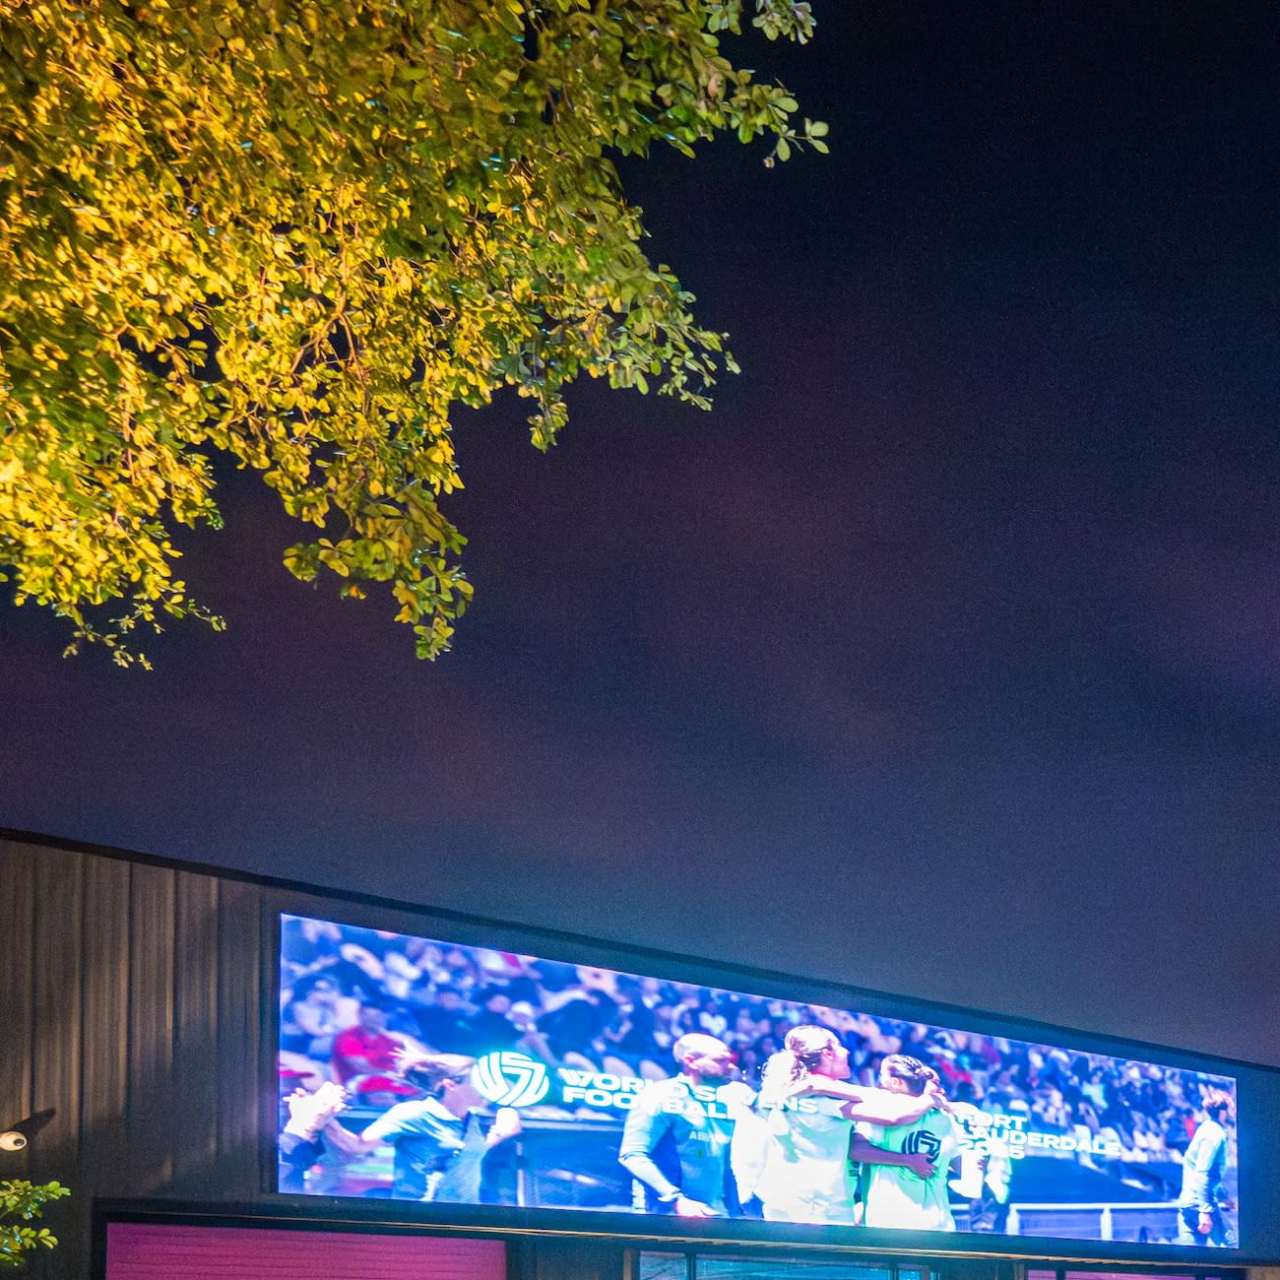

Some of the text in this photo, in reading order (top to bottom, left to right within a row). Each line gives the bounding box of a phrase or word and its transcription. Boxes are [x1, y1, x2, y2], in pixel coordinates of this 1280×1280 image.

[558, 1068, 689, 1098] WORD
[563, 1087, 741, 1121] FOOBAL
[958, 1137, 1025, 1160] 205
